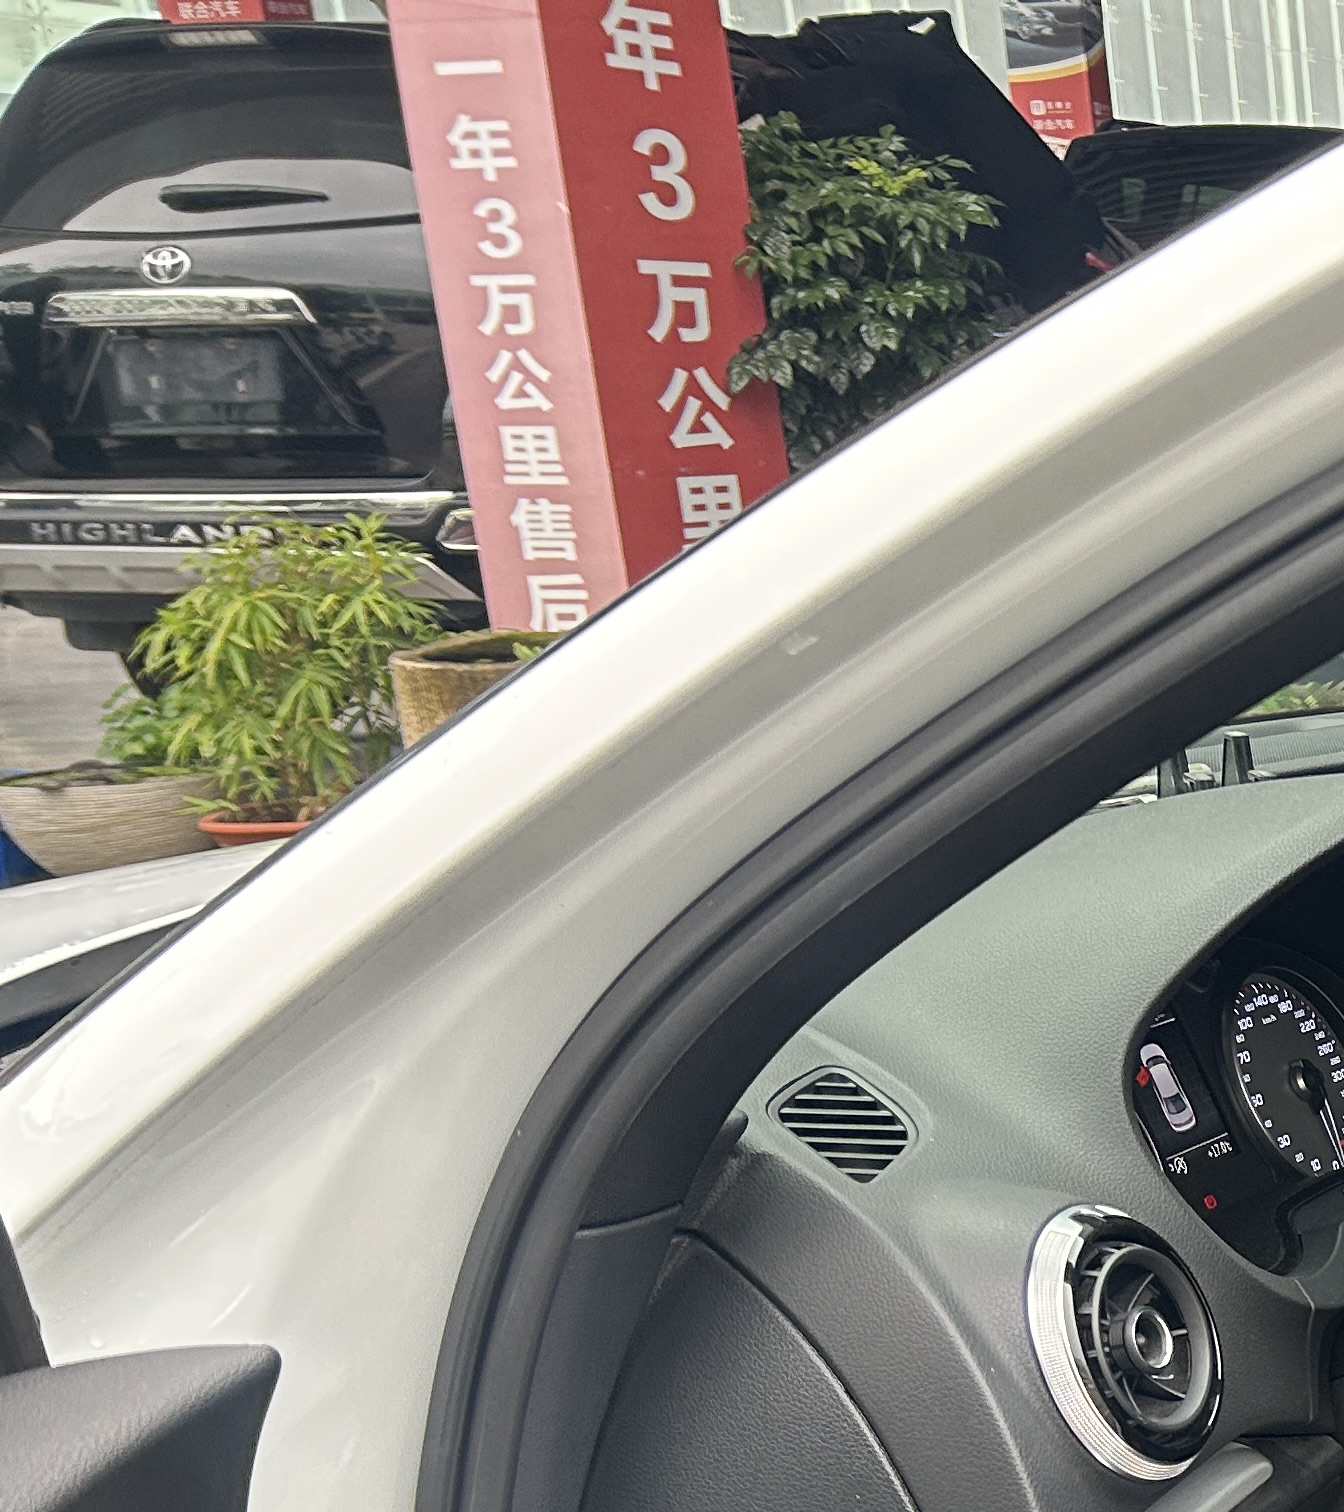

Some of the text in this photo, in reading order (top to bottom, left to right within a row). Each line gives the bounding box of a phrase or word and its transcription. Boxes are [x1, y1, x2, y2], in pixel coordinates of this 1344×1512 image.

[600, 0, 744, 550] 年3万公里
[433, 58, 590, 632] 一年3万公里售后
[1238, 1017, 1253, 1031] 100
[1300, 1019, 1315, 1033] 220
[1237, 1051, 1251, 1065] 70
[1277, 1135, 1290, 1148] 30
[1311, 1159, 1321, 1172] 10
